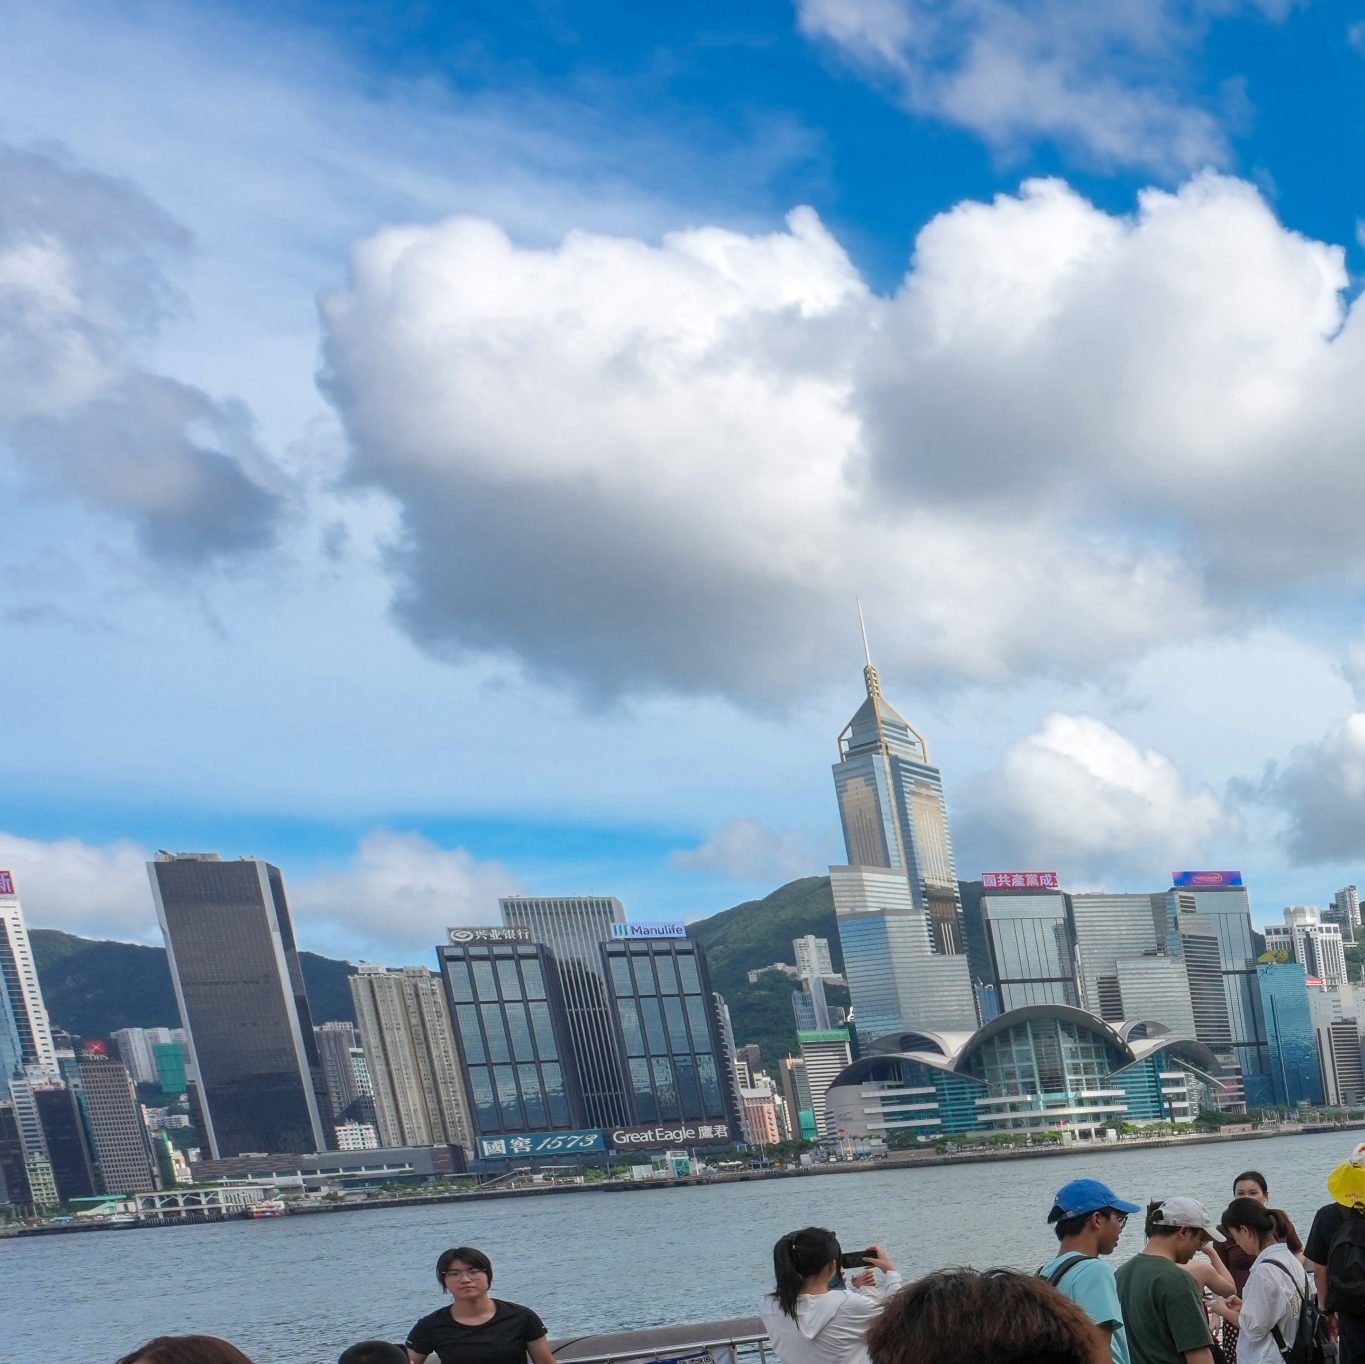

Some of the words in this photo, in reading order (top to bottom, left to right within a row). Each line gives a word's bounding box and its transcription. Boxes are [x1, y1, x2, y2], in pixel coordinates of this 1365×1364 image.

[474, 928, 530, 941] 兴业银行
[631, 924, 684, 936] Manulife
[88, 1053, 109, 1061] DBS
[612, 1127, 655, 1144] Great
[656, 1126, 695, 1144] Eagle
[698, 1125, 728, 1139] 鷹君
